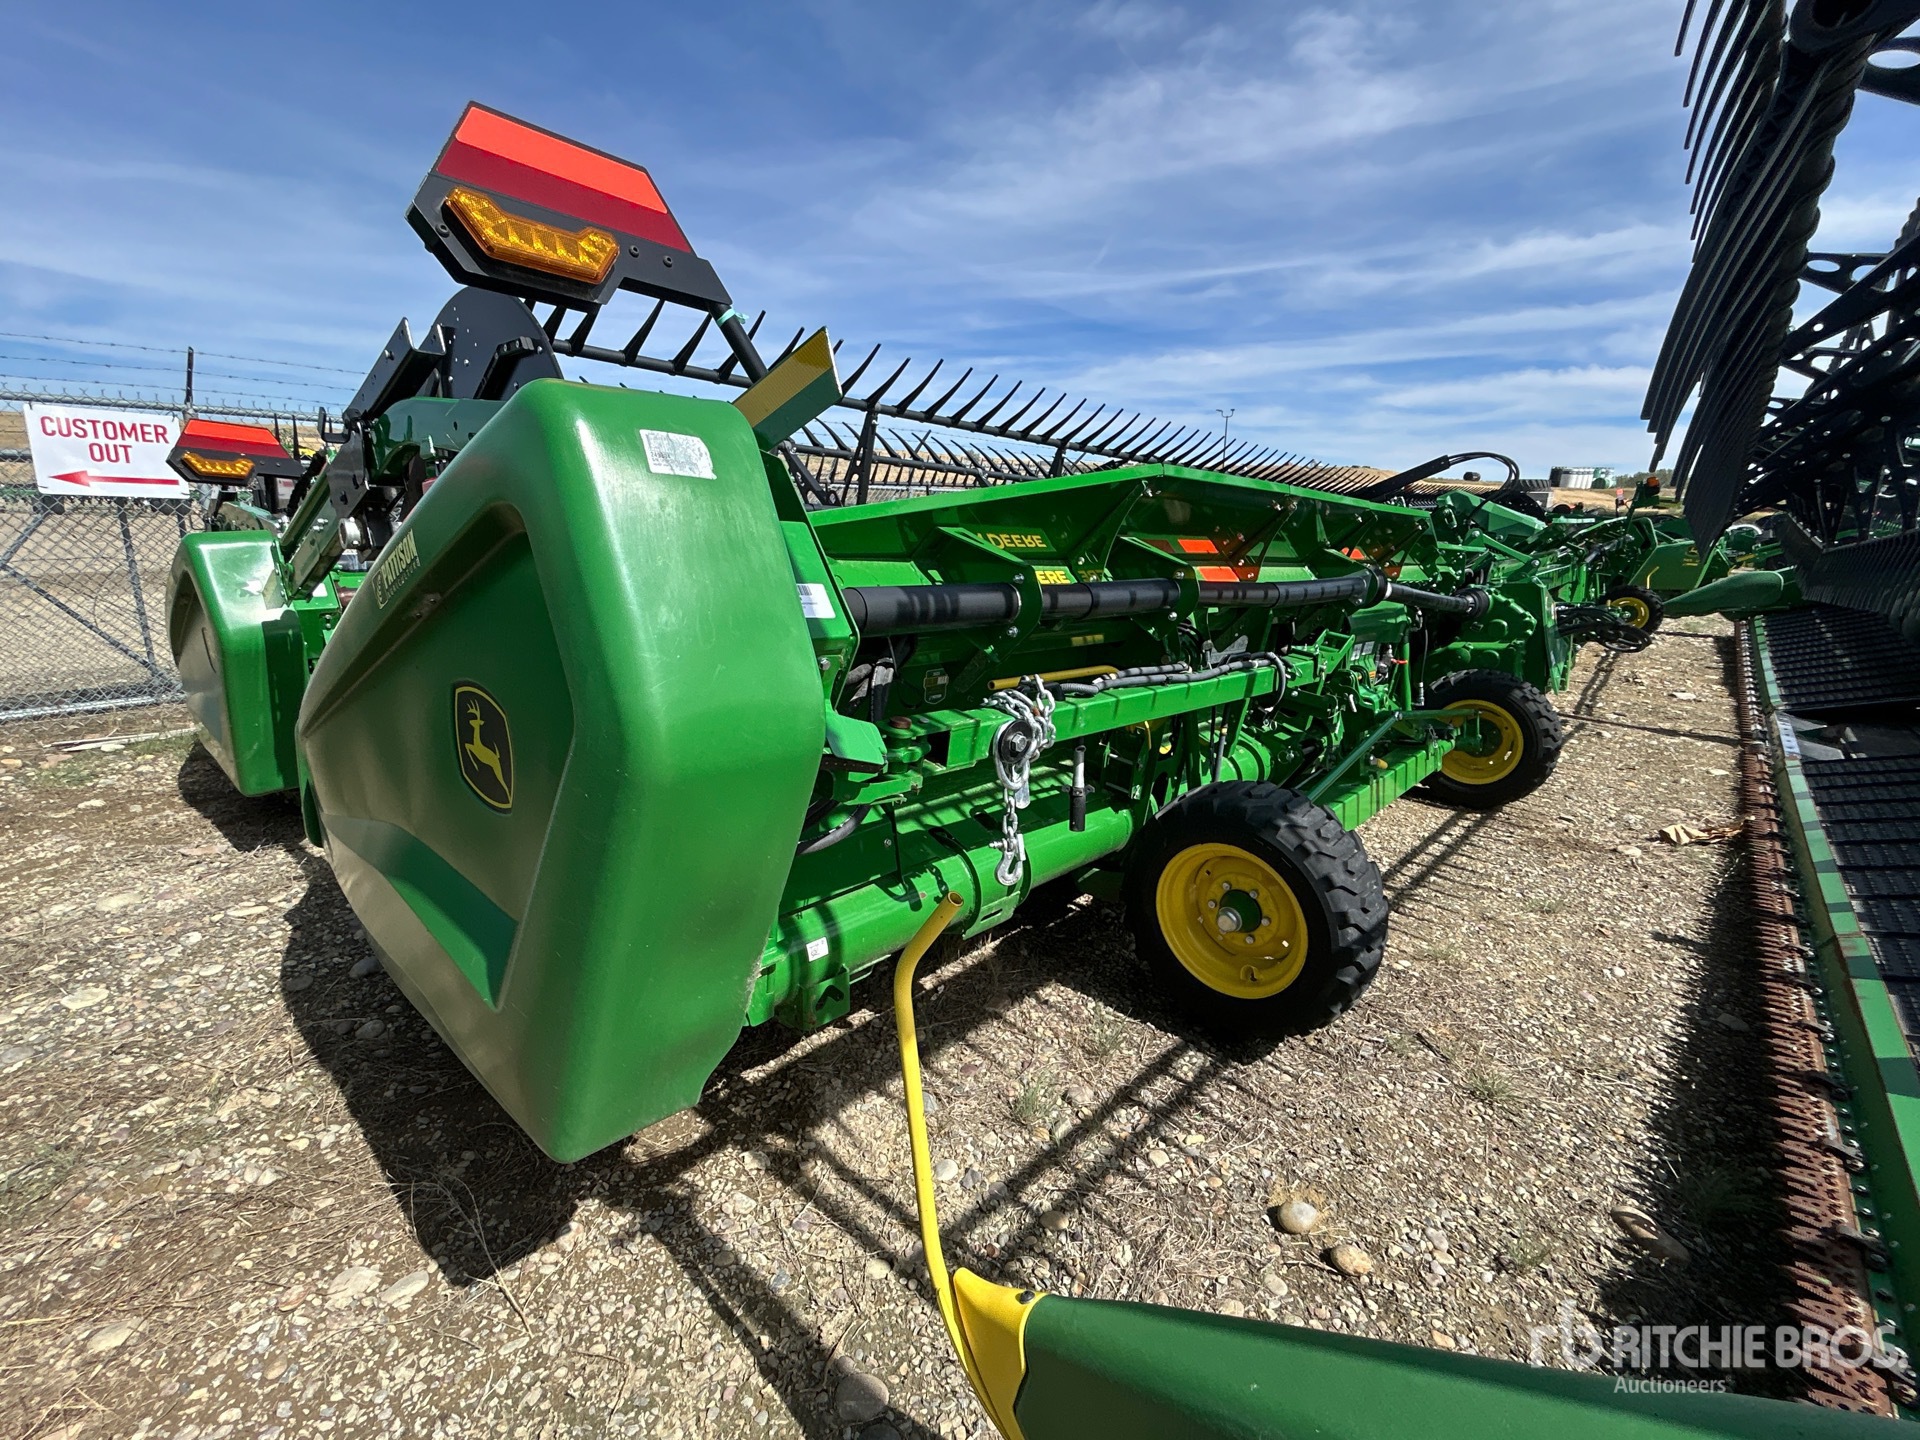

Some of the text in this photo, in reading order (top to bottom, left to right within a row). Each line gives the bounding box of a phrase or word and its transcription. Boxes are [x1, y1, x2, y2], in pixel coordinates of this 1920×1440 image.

[40, 416, 169, 444] CUSTOMER
[88, 442, 132, 463] OUT
[381, 528, 418, 589] PATTISON
[1034, 570, 1071, 584] ERE
